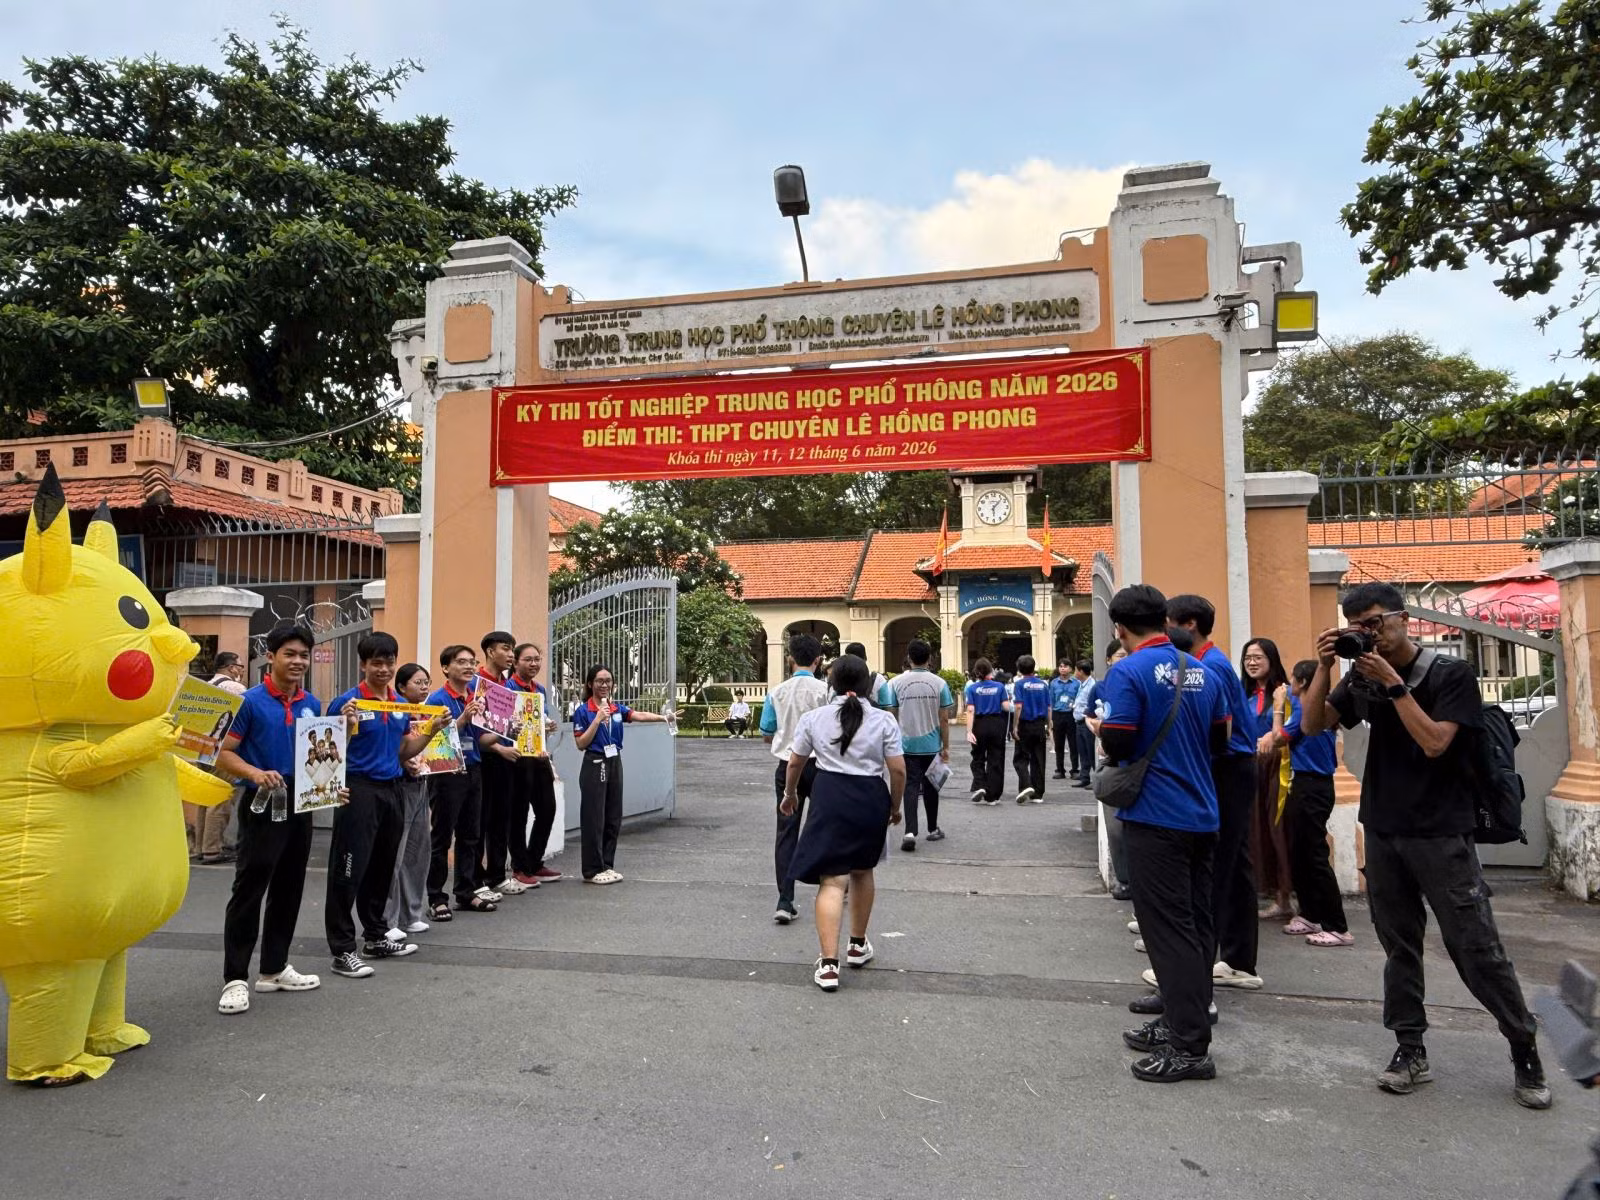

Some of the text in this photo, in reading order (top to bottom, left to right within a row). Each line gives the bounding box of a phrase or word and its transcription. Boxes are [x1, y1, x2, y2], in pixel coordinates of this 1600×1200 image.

[554, 296, 1080, 358] TRƯỜNG TRUNG HỌC PHỔ THÔNG CHUYÊN LÊ HỒNG PHONG
[517, 372, 1117, 422] KỲ THI TỐT NGHIỆP TRUNG HỌC PHỔ THÔNG NĂM 2026
[583, 407, 1036, 447] ĐIỂM THI: THPT CHUYÊN LÊ HỒNG PHONG
[668, 441, 936, 466] Khóa thi ngày 11, 12 tháng 6 năm 2026
[1002, 596, 1026, 606] PHONG
[1184, 672, 1204, 685] 2024
